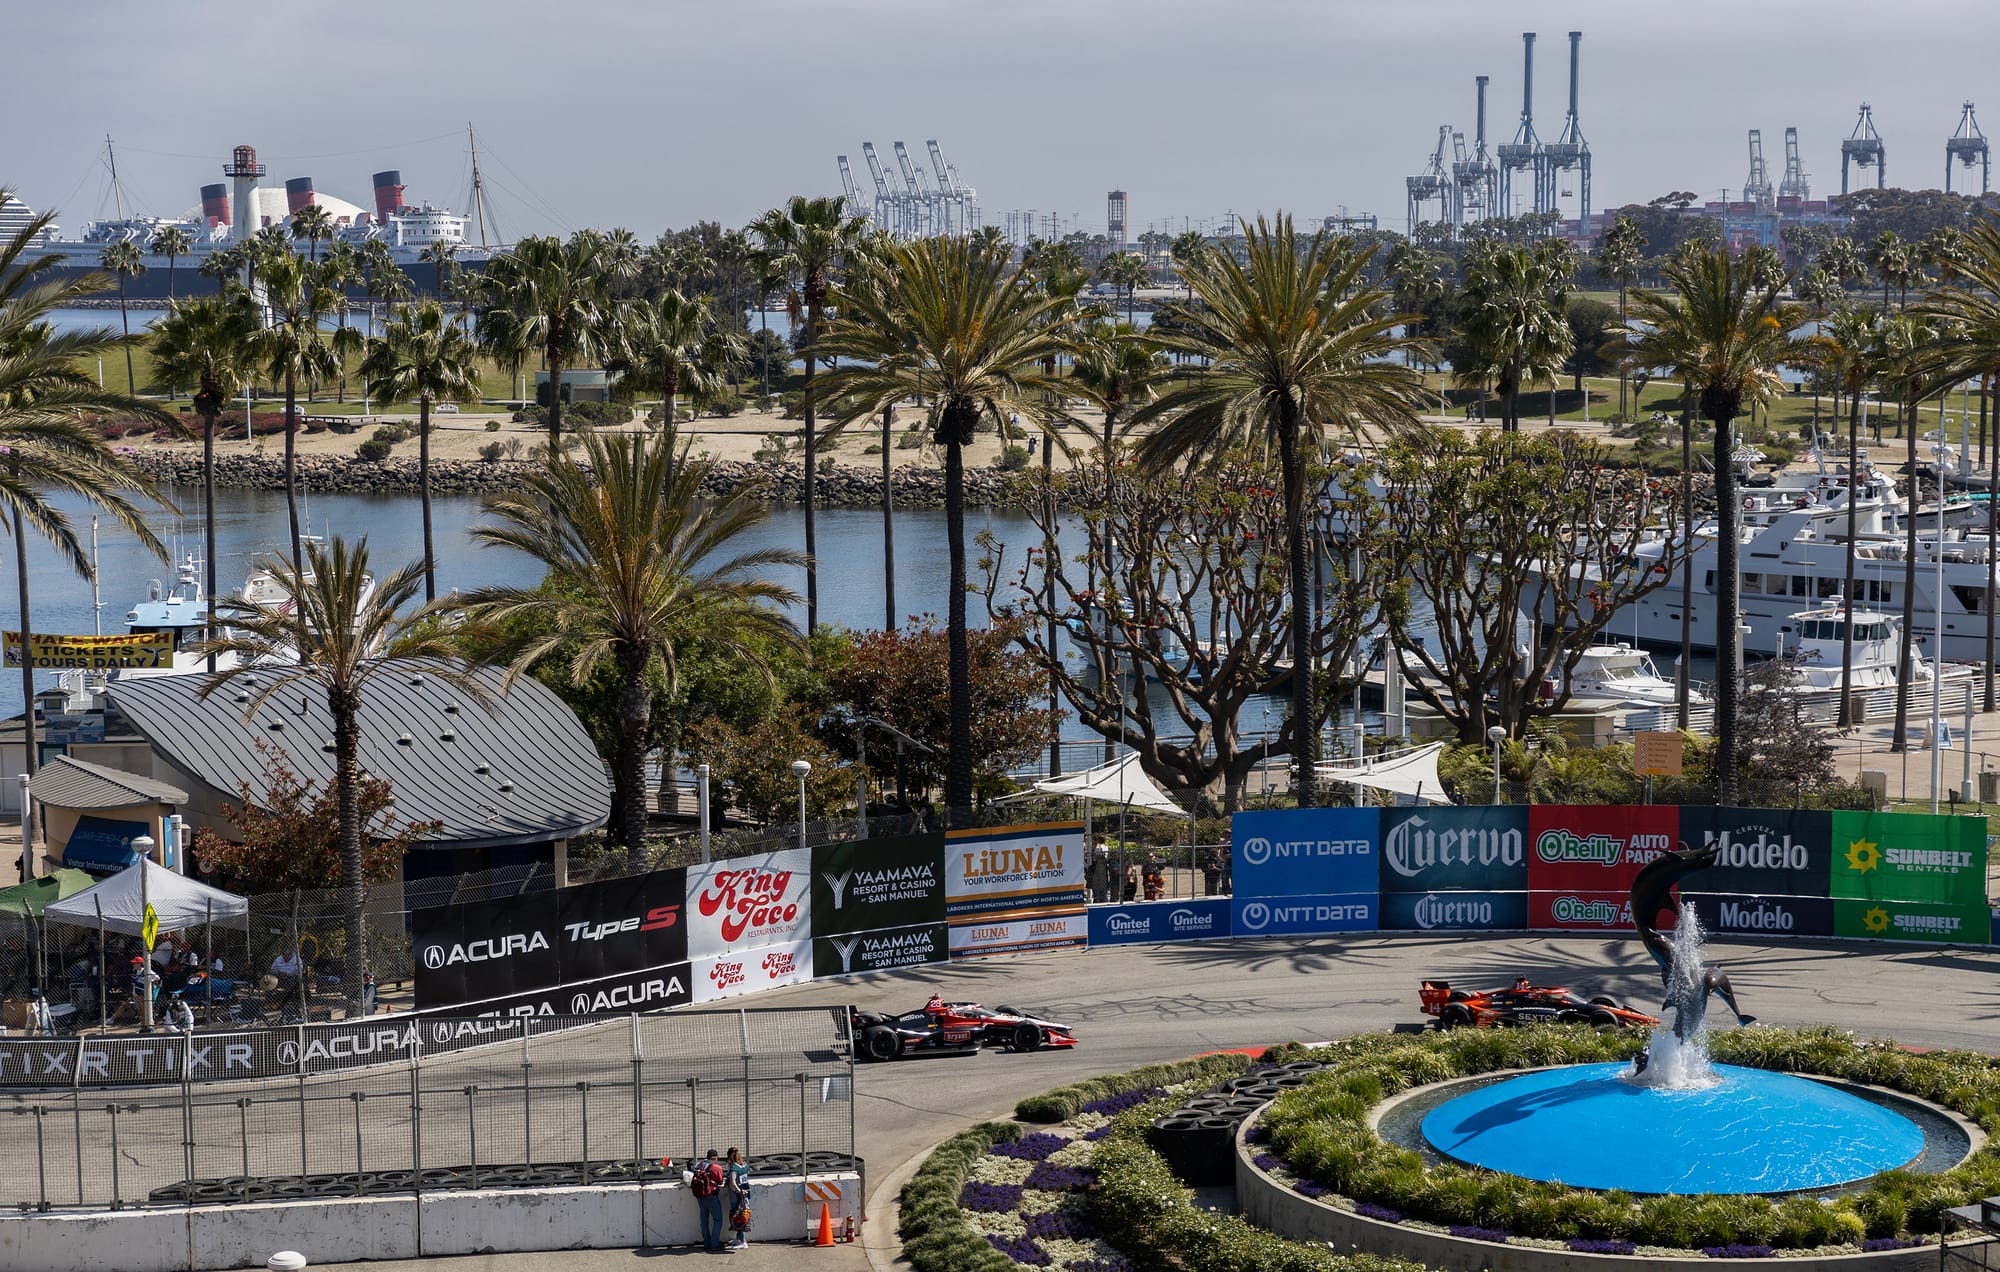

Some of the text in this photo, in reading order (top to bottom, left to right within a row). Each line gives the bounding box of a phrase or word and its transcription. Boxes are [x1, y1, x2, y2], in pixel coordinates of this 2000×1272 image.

[7, 632, 170, 645] WHALE WATCH
[40, 646, 134, 656] TICKETS
[31, 657, 147, 668] TOURS DAILY
[1736, 825, 1775, 836] CERVEZA
[1275, 841, 1314, 857] NTT
[1385, 814, 1523, 877] Cuervo
[1538, 830, 1669, 864] O'Reilly AUTO
[1704, 830, 1808, 870] Modelo
[67, 858, 123, 872] Visitor Information
[962, 844, 1064, 878] LiUNA!
[1885, 848, 1972, 868] SUNBELT
[1897, 865, 1959, 873] RENTALS
[964, 870, 1064, 886] YOUR WORKFORCE SOLUTION
[698, 868, 792, 917] King
[854, 884, 889, 896] RESORT
[900, 879, 936, 890] CASINO
[868, 894, 887, 904] SAN
[890, 890, 928, 901] MANUEL
[946, 904, 974, 912] LABORERS
[974, 901, 1014, 910] INTERNATIONAL
[1274, 907, 1314, 922] NTT
[1414, 894, 1492, 929] Cuervo
[1554, 898, 1618, 924] O'Reilly
[721, 894, 797, 942] Taco
[1111, 917, 1150, 930] United
[1174, 914, 1212, 926] United
[1720, 902, 1794, 930] Modelo
[1894, 914, 1960, 929] SUNBELT
[564, 916, 641, 942] Type
[971, 926, 1008, 939] LiUNA!
[1030, 921, 1066, 934] LiUNA!
[1902, 926, 1950, 934] RENTALS
[446, 931, 550, 966] ACURA
[862, 950, 894, 960] RESORT
[904, 944, 934, 954] CASINO
[762, 952, 794, 970] King
[875, 959, 892, 968] SAN
[894, 954, 928, 965] MANUEL
[710, 962, 744, 980] King
[770, 962, 796, 979] Taco
[718, 972, 744, 989] Taco
[591, 976, 685, 1012] ACURA
[930, 1000, 942, 1008] 28
[1428, 1002, 1440, 1012] 14
[454, 1002, 556, 1039] ACURA
[1518, 1012, 1560, 1021] SEXTON
[947, 1032, 968, 1040] bryant
[304, 1027, 424, 1062] ACURA
[126, 1044, 255, 1074] TIXR
